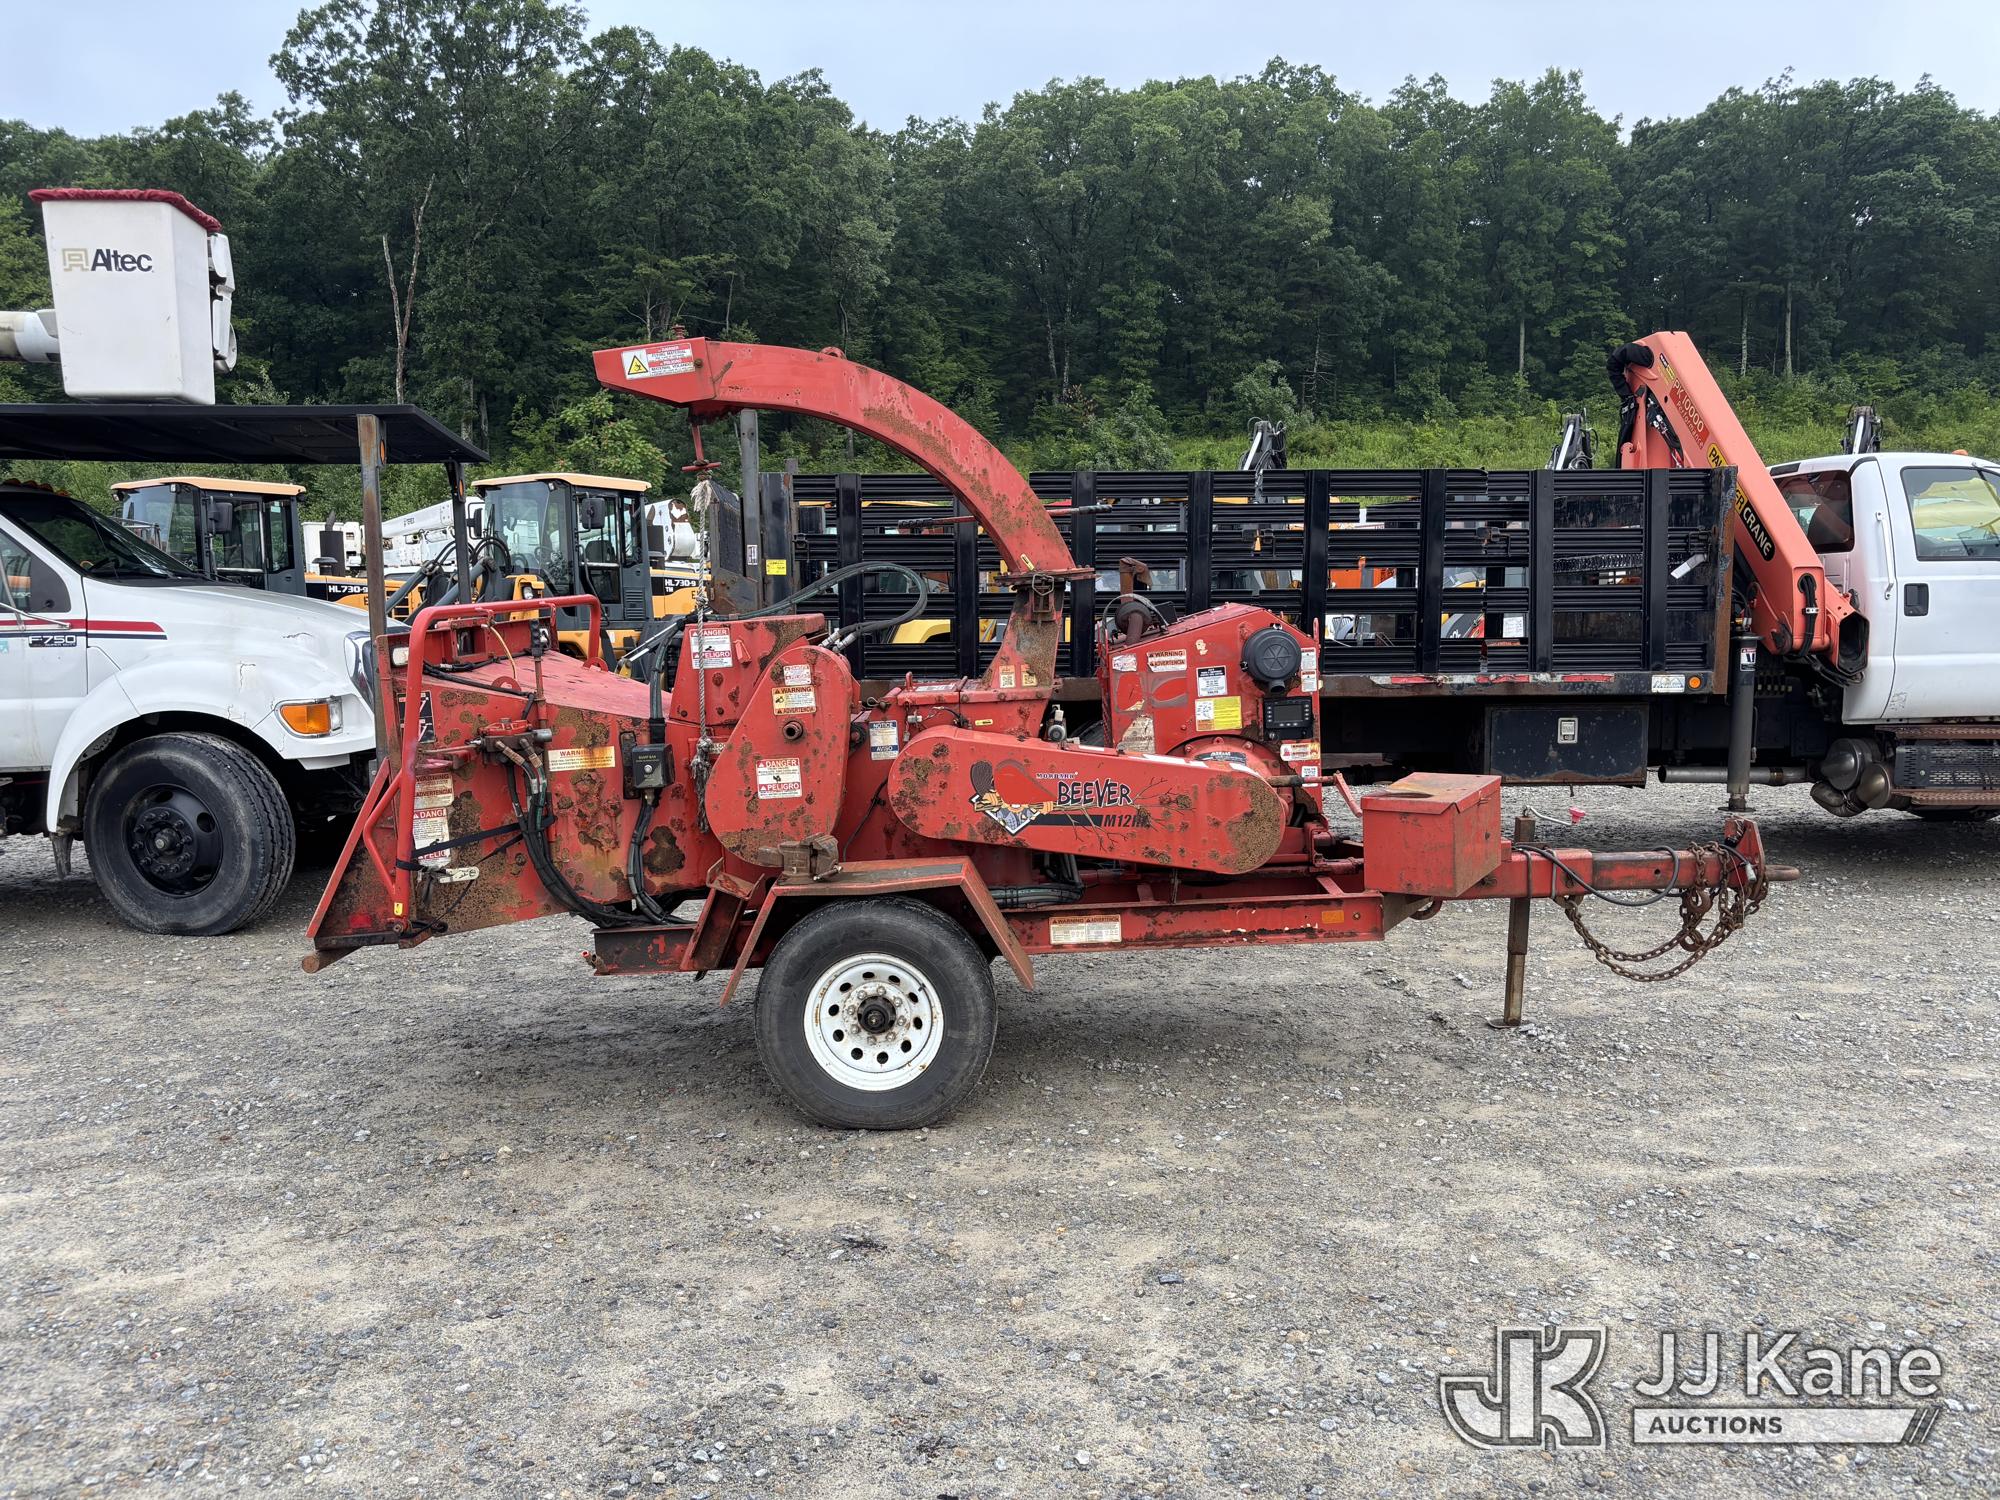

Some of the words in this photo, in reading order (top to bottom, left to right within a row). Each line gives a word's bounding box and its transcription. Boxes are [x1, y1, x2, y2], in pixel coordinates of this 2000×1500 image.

[91, 248, 153, 272] Altec
[1673, 380, 1684, 399] PK
[1682, 394, 1704, 433] 10000
[1743, 507, 1772, 556] CRANE
[766, 760, 797, 768] DANGER
[416, 773, 449, 782] WARNING
[767, 783, 799, 791] PELIGRO
[1057, 778, 1133, 808] BEEVER
